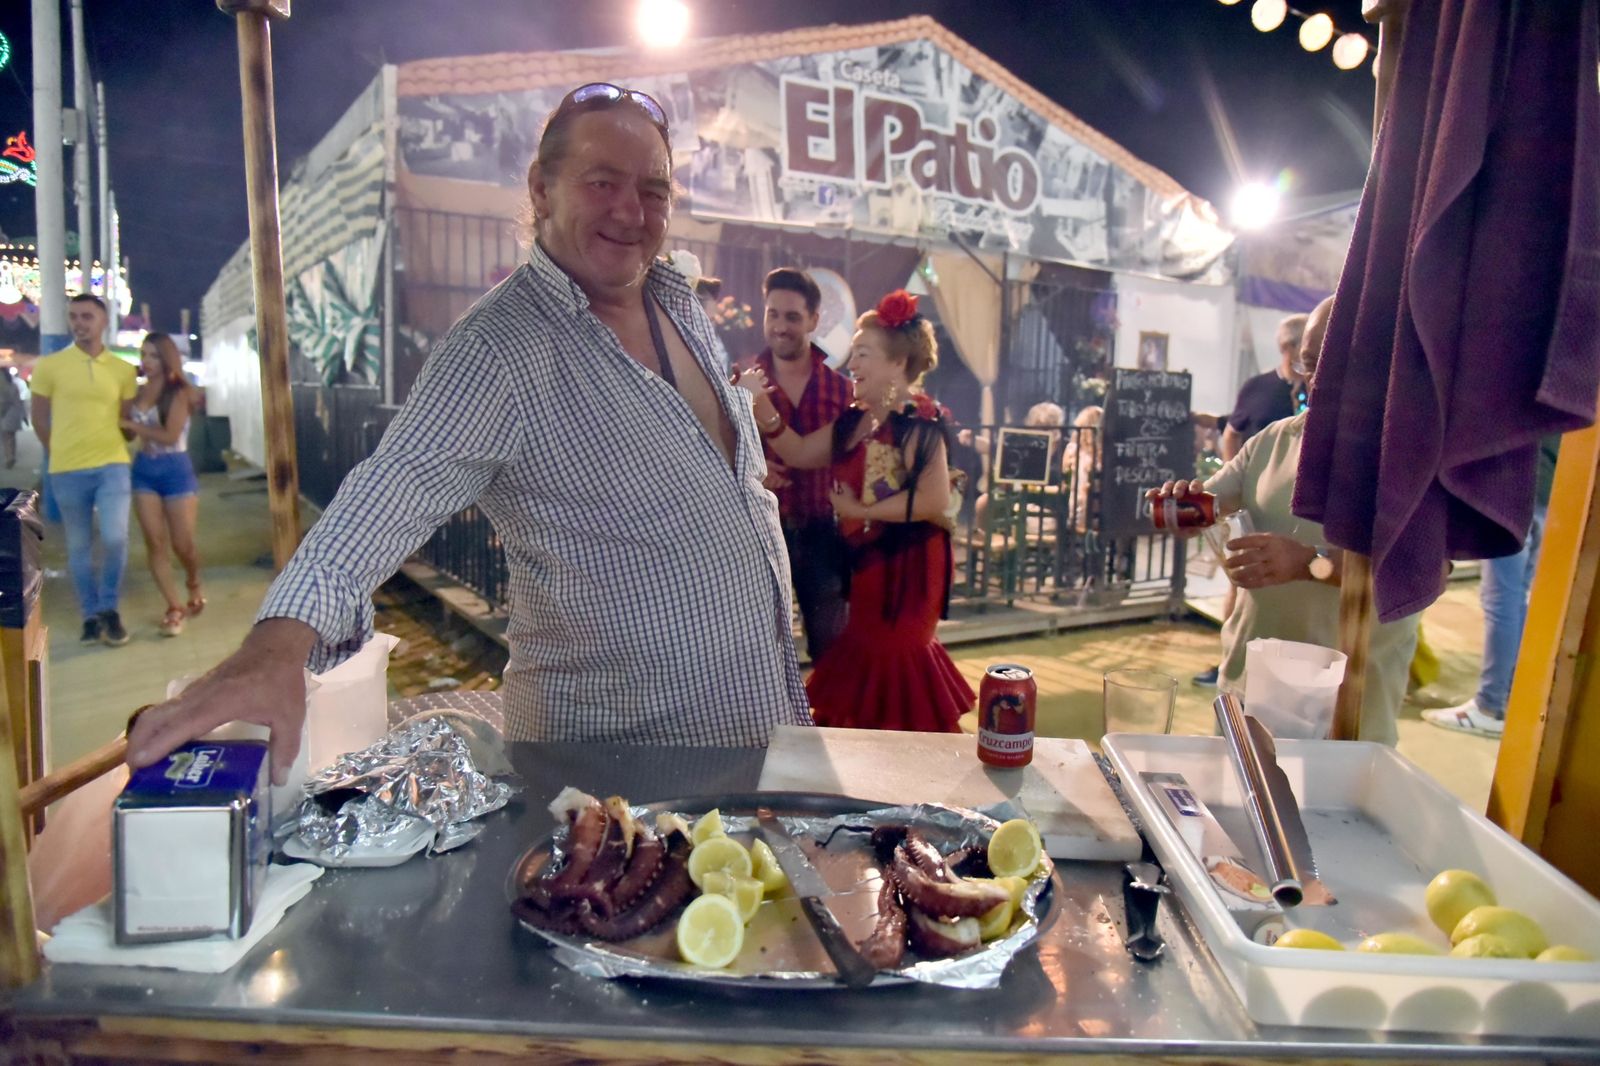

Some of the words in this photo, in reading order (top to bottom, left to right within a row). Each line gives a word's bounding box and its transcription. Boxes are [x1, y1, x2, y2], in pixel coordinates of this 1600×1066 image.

[840, 60, 900, 88] Caseta
[783, 78, 857, 181] El
[862, 93, 1040, 213] Patio
[981, 734, 1032, 750] ruzcampo
